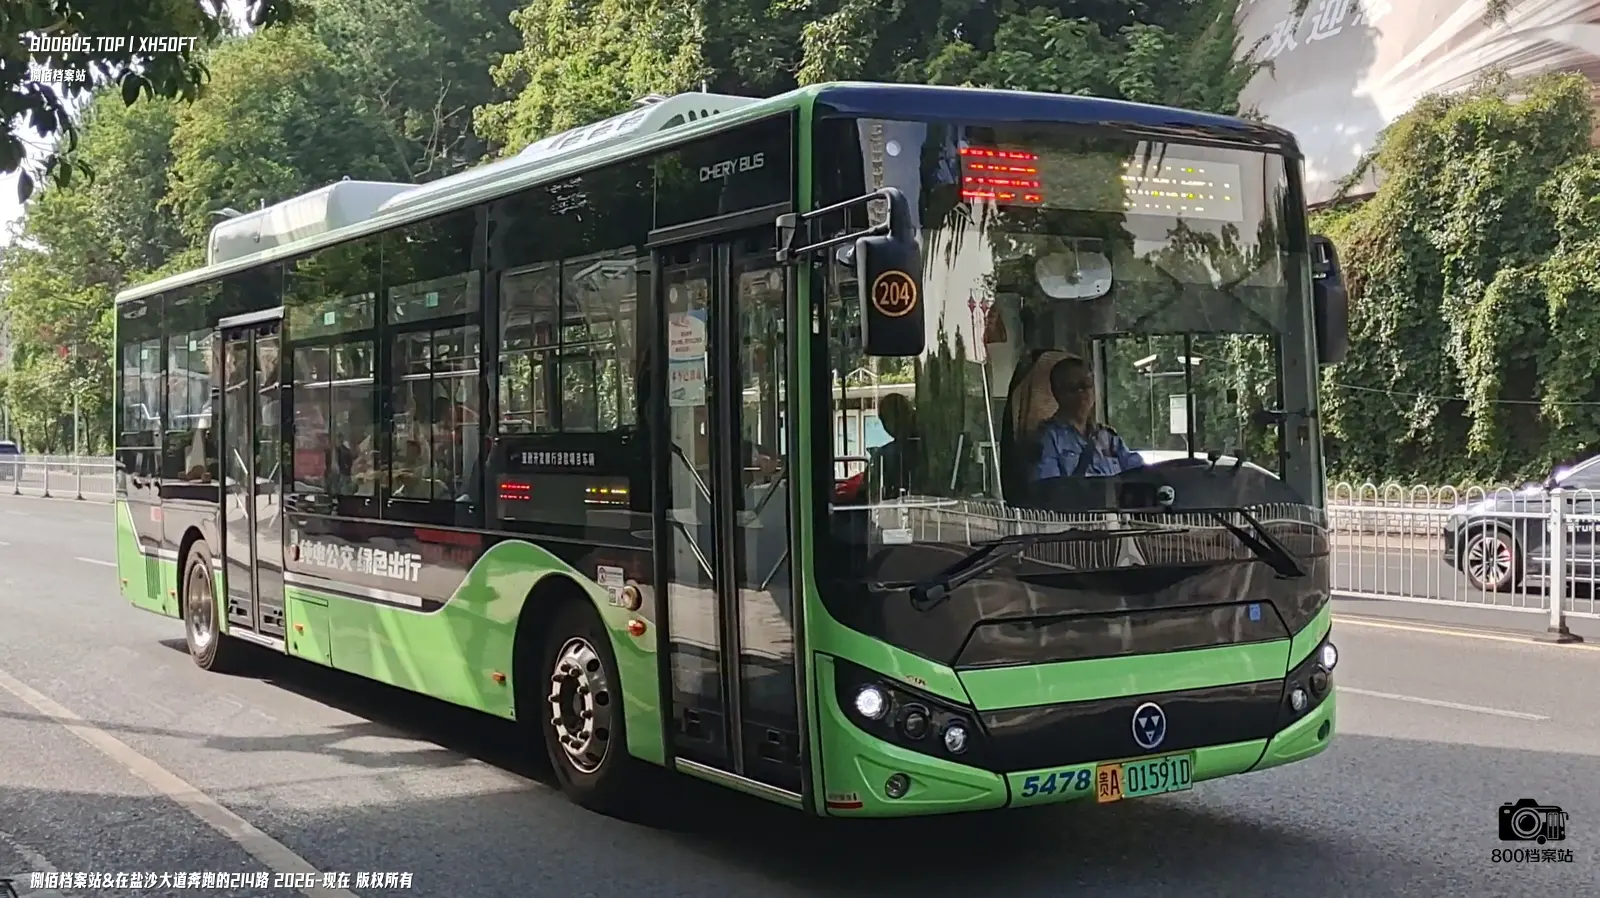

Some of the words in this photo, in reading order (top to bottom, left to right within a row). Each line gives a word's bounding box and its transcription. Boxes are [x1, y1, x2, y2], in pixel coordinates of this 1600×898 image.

[1263, 0, 1366, 57] 欢迎
[699, 159, 739, 182] CHERY
[739, 152, 765, 172] BUS
[879, 281, 911, 306] 204
[299, 539, 355, 573] 纯电公交
[356, 546, 423, 582] 绿色出行
[1021, 769, 1092, 798] 5478
[1098, 768, 1121, 797] 贵A
[1128, 759, 1190, 792] 01591D
